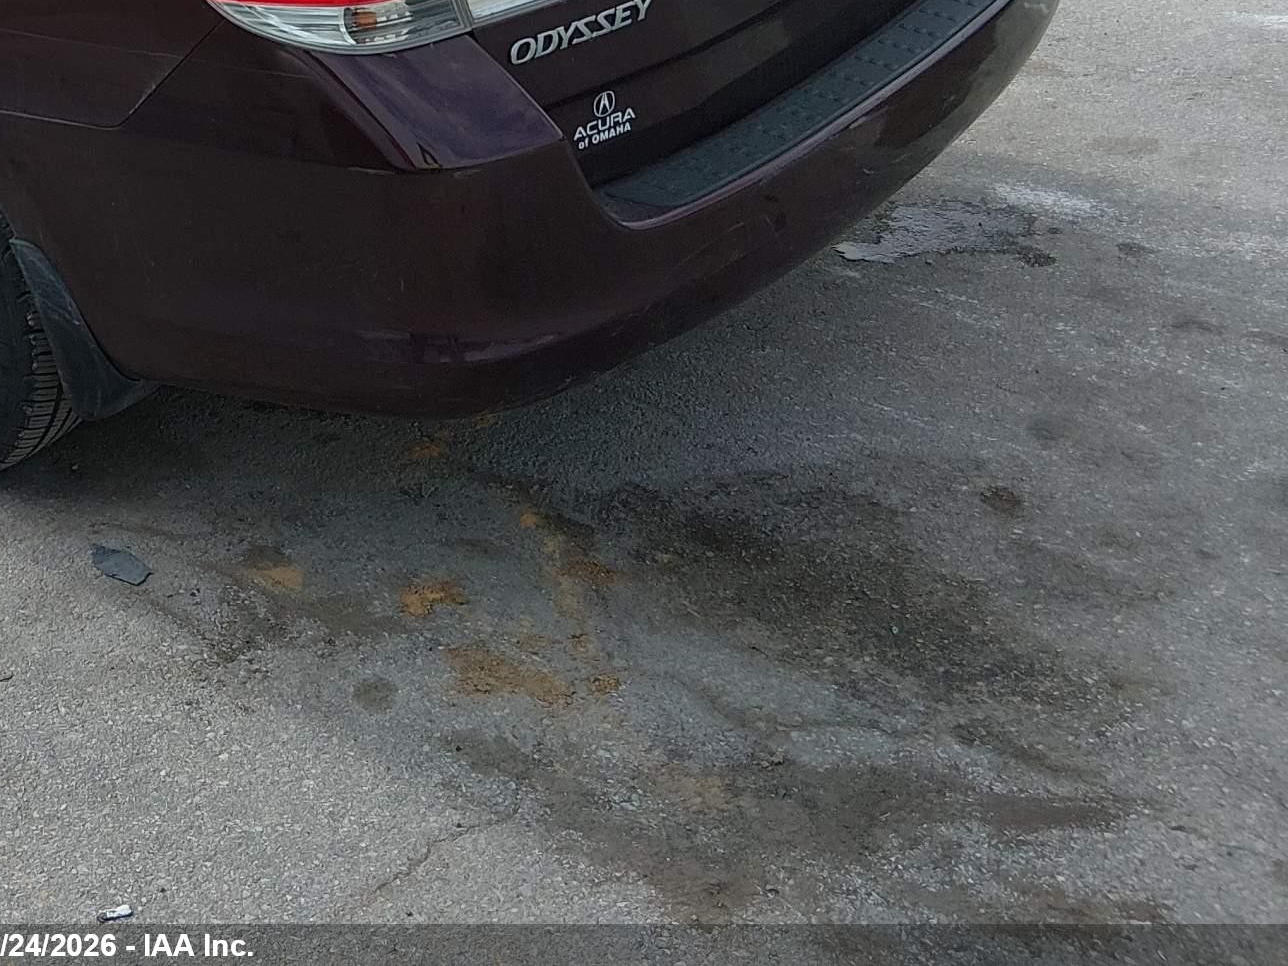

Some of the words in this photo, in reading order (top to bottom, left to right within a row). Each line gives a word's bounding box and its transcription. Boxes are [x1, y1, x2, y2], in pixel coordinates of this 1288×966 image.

[574, 107, 636, 141] ACURA
[578, 139, 589, 150] of
[591, 123, 632, 145] OMAHA
